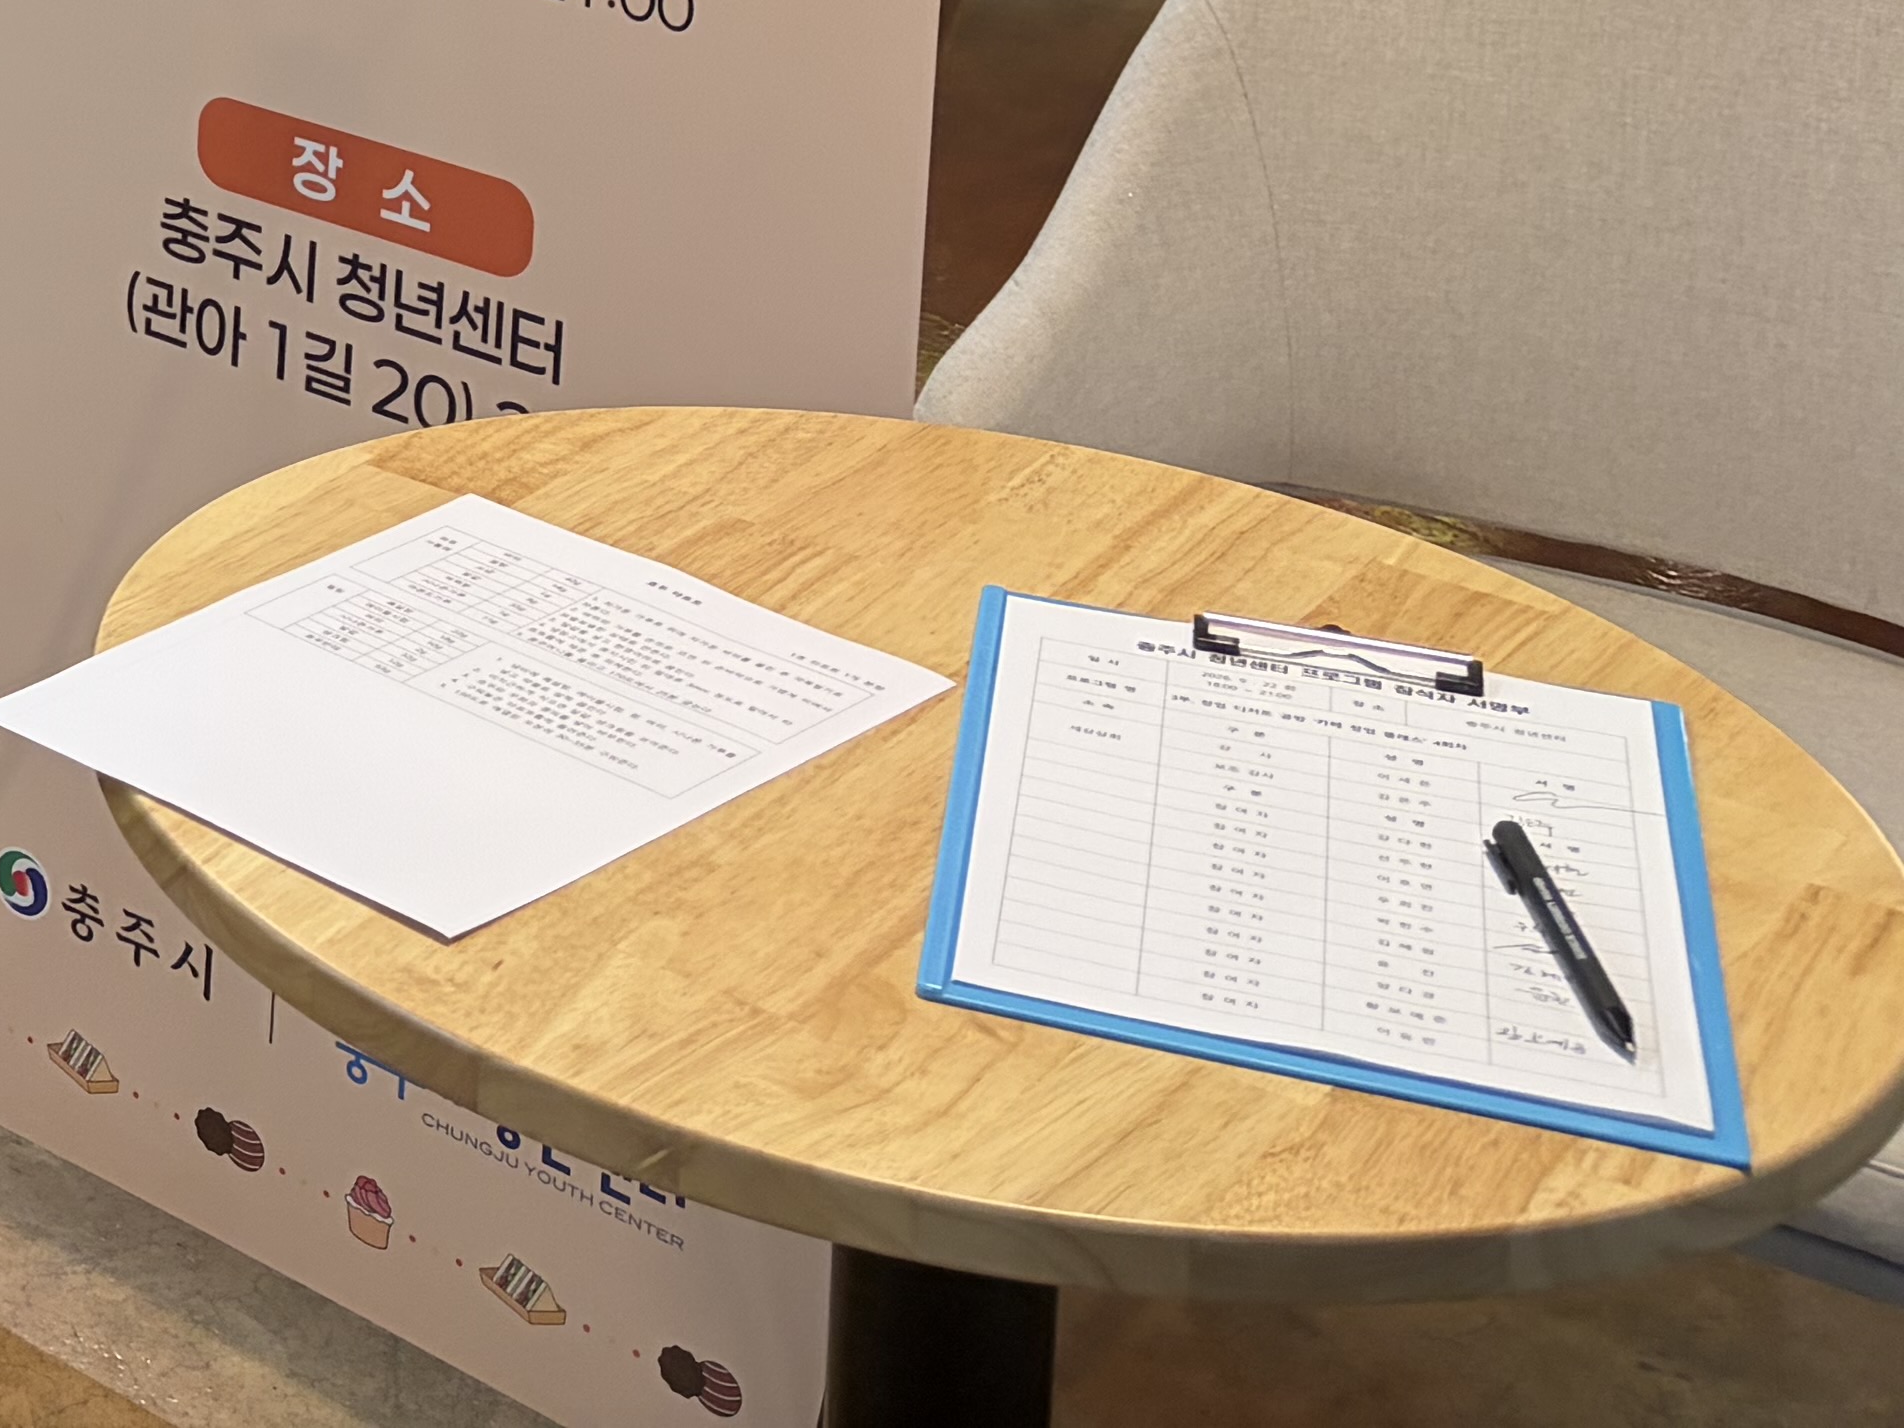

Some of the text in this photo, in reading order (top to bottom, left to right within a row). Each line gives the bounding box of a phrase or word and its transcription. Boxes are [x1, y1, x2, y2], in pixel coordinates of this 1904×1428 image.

[159, 197, 564, 385] 충주시 청년센터
[61, 881, 215, 1002] 충주시
[421, 1112, 520, 1169] CHUNGJU
[524, 1162, 594, 1207] YOUTH
[599, 1200, 685, 1251] CENTER
